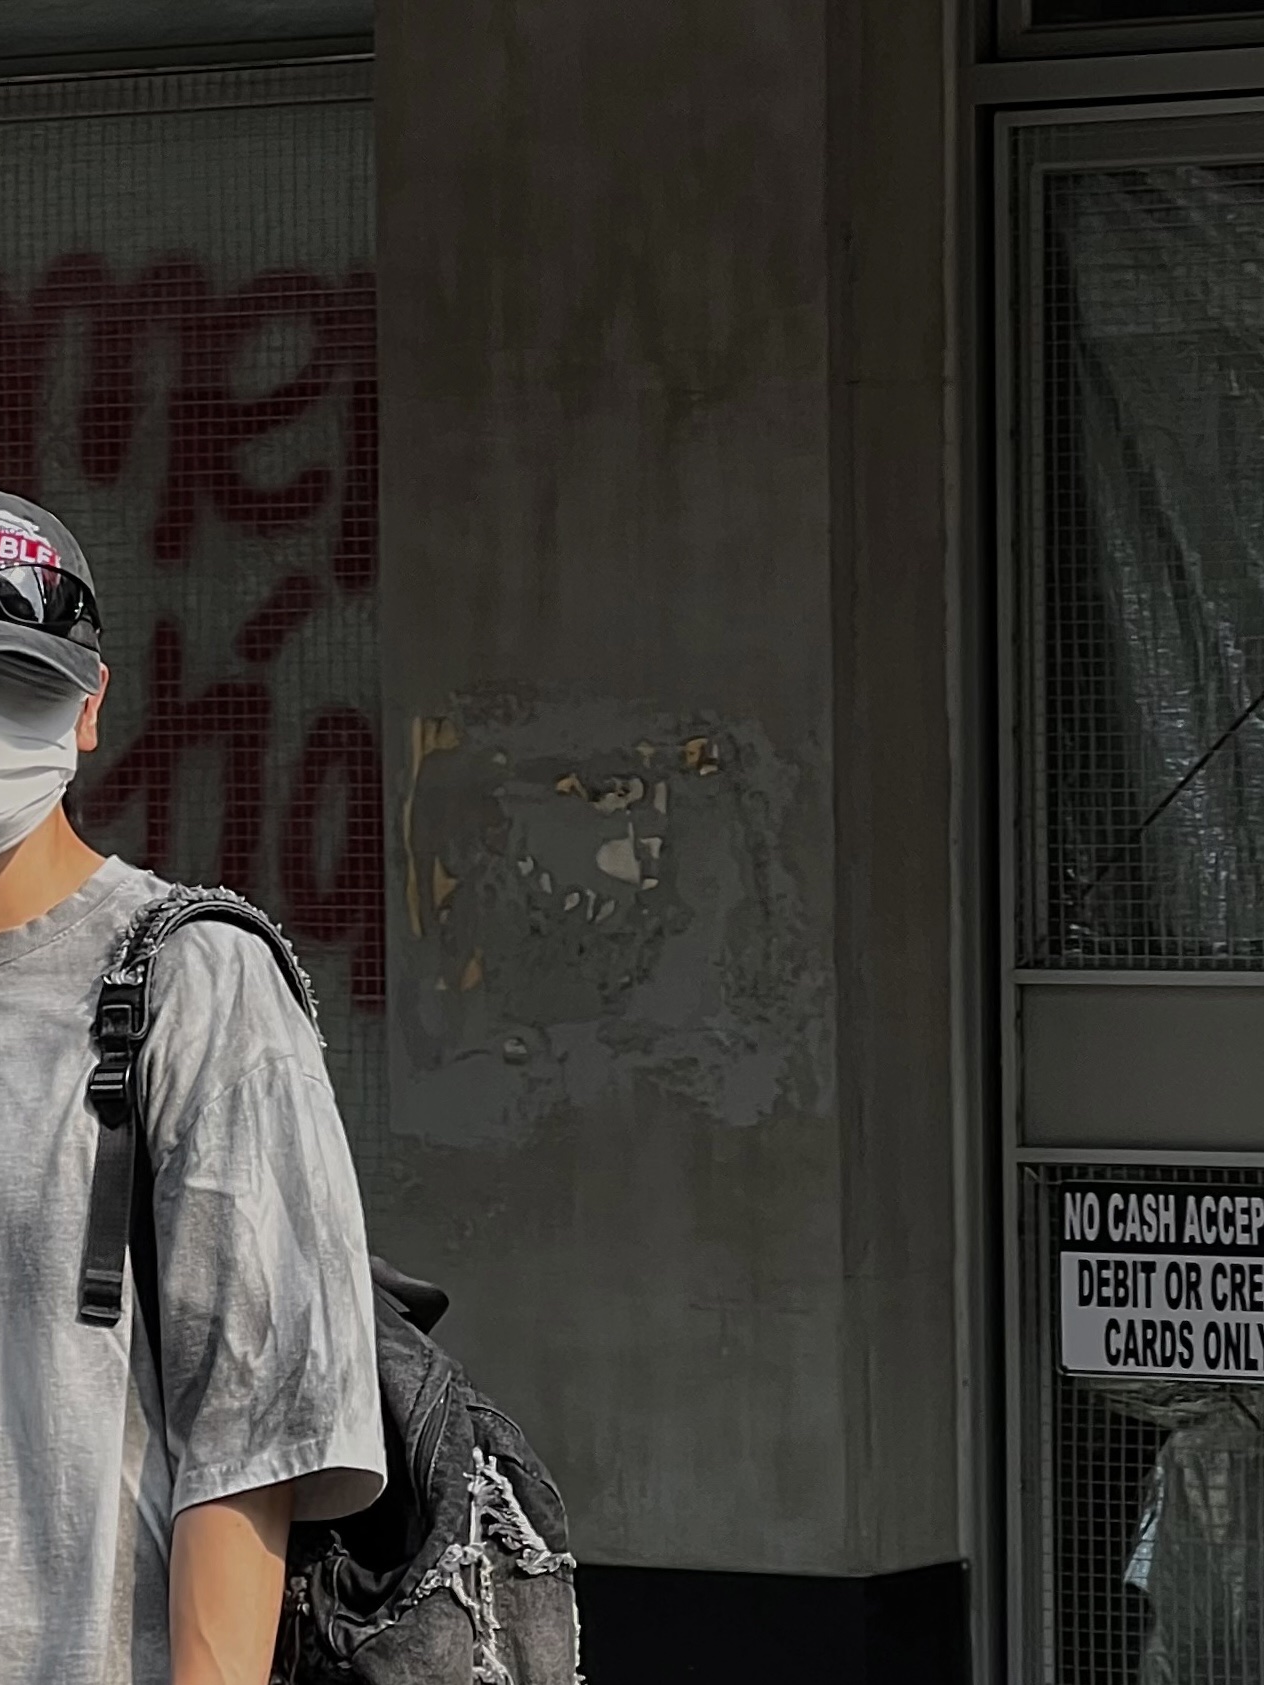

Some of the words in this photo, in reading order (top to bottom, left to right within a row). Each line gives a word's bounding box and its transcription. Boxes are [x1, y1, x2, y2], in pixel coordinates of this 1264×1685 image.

[1064, 1192, 1100, 1242] NO
[1107, 1193, 1176, 1243] CASH
[1077, 1259, 1157, 1309] DEBIT
[1165, 1261, 1203, 1311] OR
[1211, 1262, 1264, 1312] CRE
[1104, 1318, 1195, 1369] CARDS
